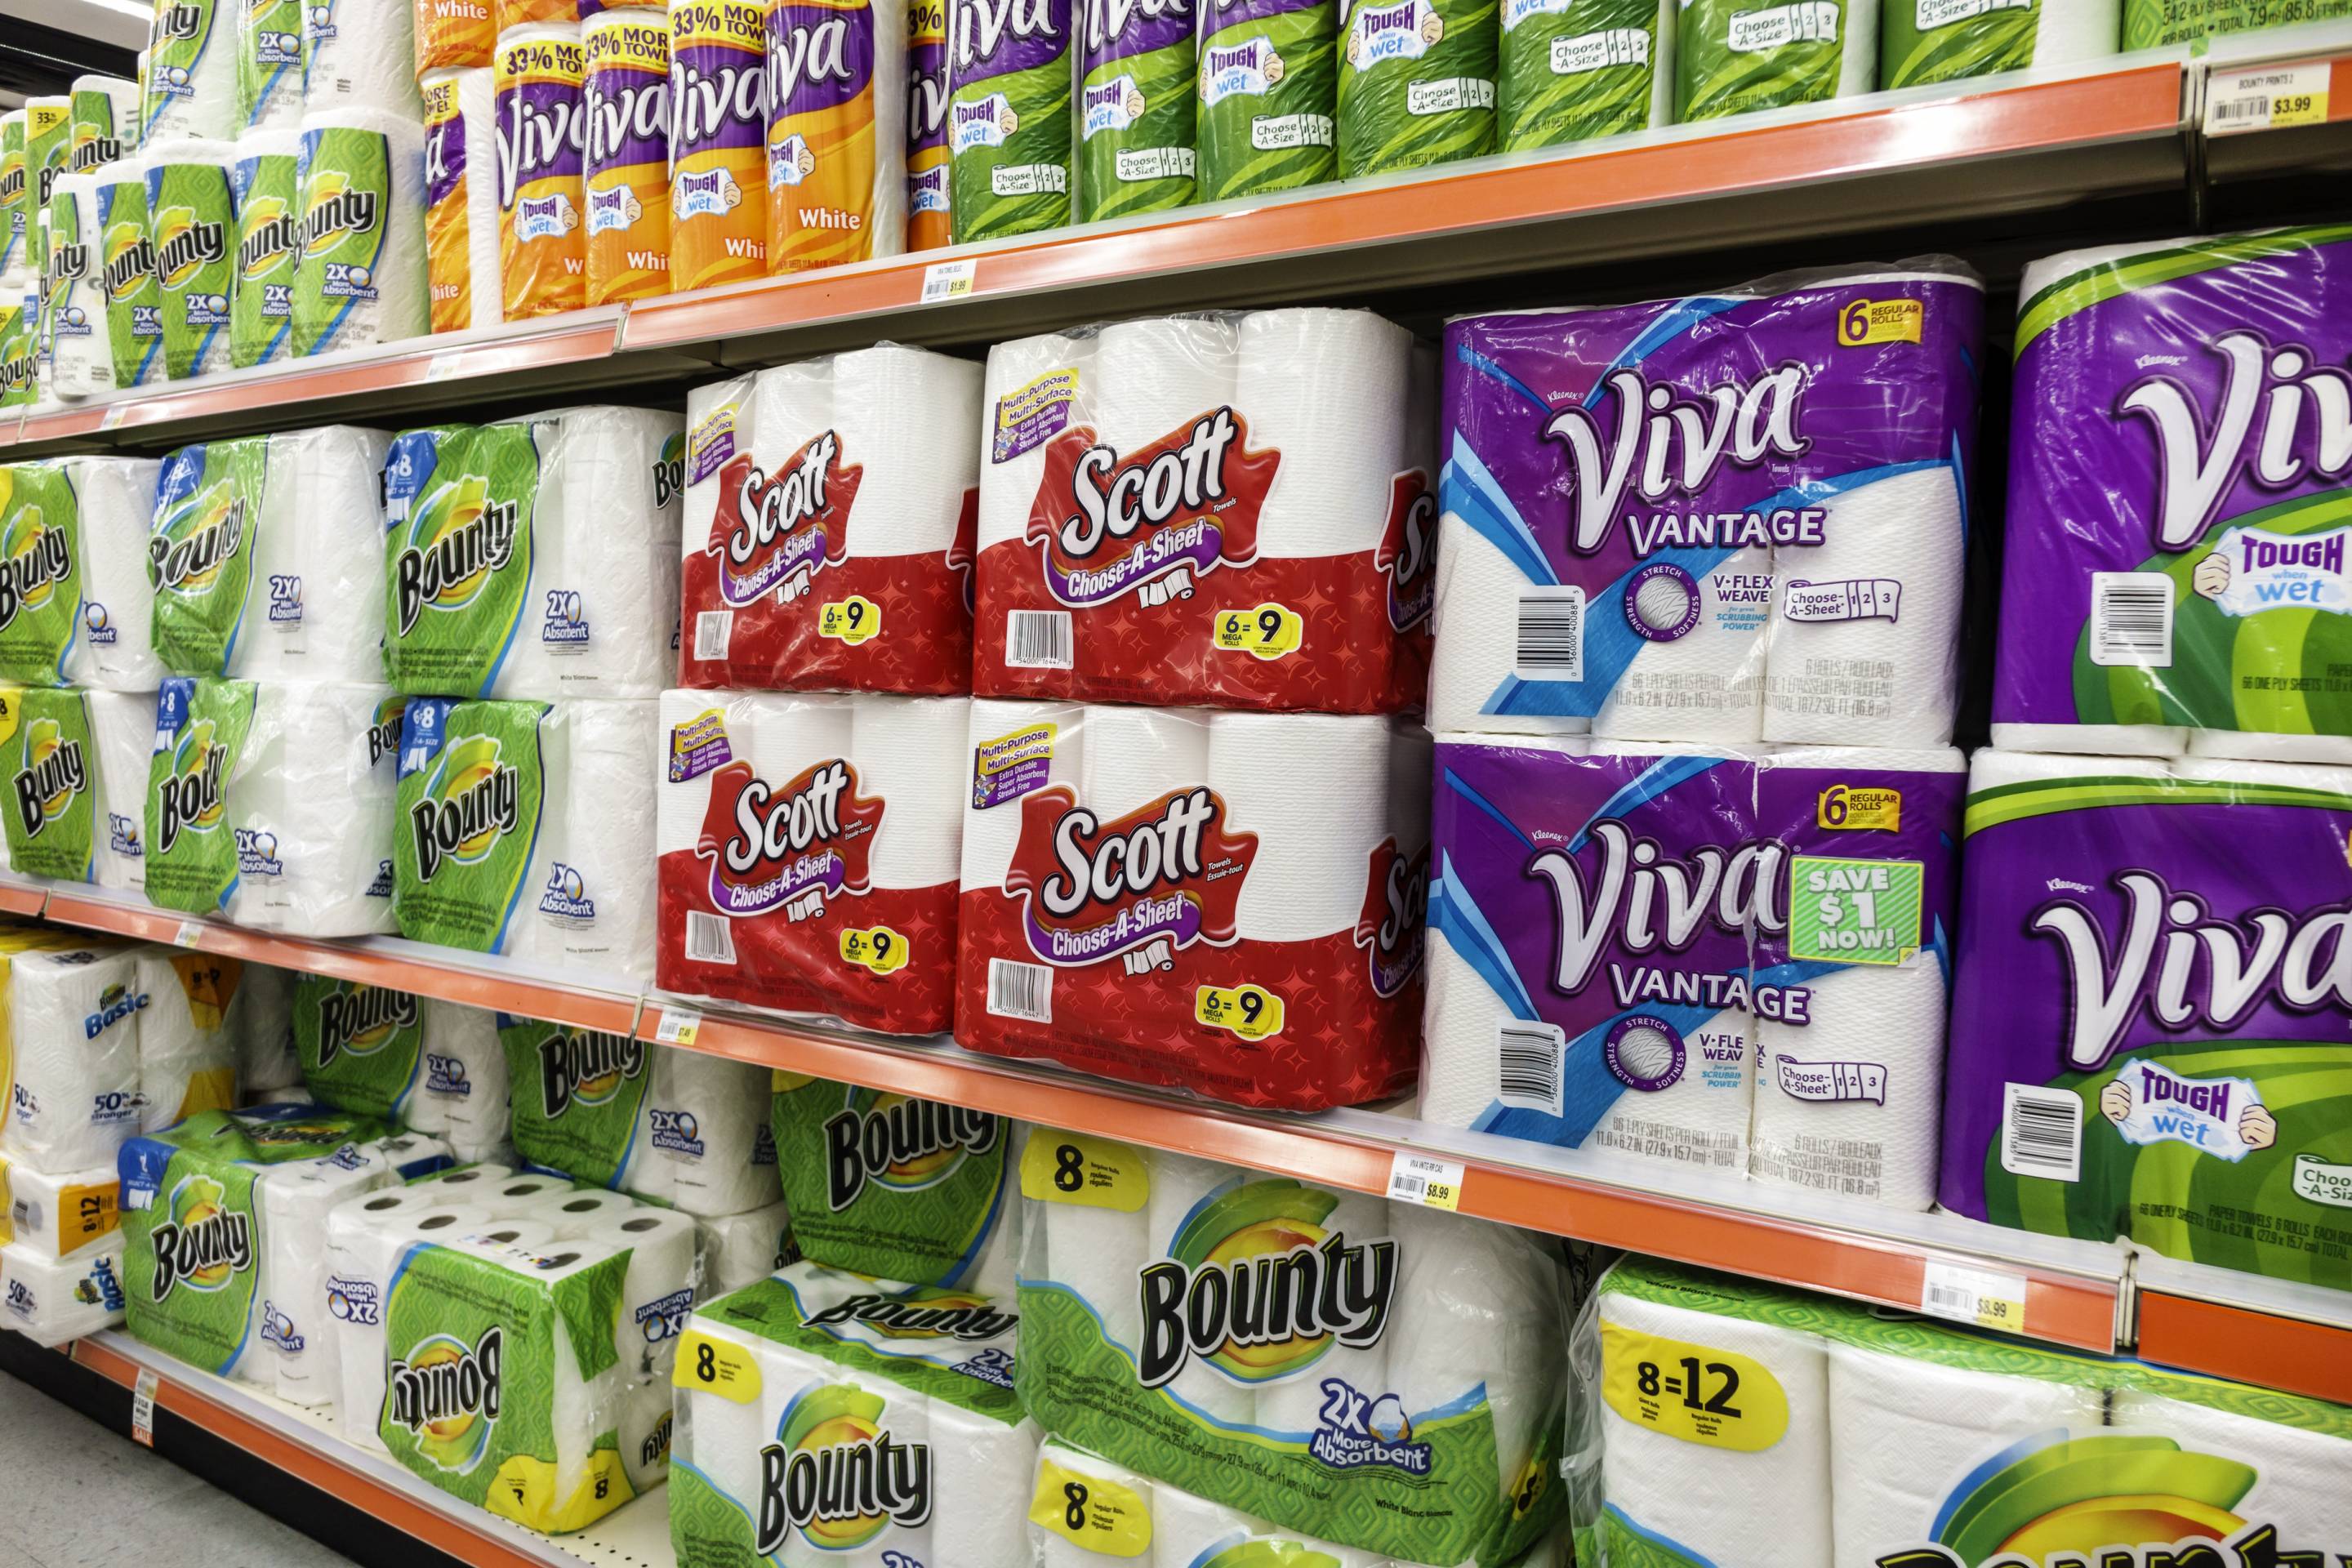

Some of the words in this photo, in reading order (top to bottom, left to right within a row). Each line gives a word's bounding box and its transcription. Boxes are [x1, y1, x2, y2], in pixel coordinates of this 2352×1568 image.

[436, 1, 488, 20] White
[1364, 2, 1414, 41] TOUGH
[2219, 15, 2244, 30] TOTAL
[2248, 6, 2267, 28] 7.9
[673, 7, 721, 38] 33%
[1735, 15, 1785, 34] Choose
[260, 33, 280, 48] 2X
[1370, 36, 1405, 58] wet
[1555, 41, 1602, 58] Choose
[506, 48, 552, 76] 33%
[1210, 47, 1257, 78] TOUGH
[1217, 74, 1249, 95] wet
[2238, 76, 2265, 90] BOUNTY
[2265, 74, 2287, 86] PRINTS
[1086, 79, 1122, 110] TOUGH
[1413, 87, 1456, 101] Choose
[2274, 96, 2311, 114] $3.99
[956, 98, 995, 124] TOUGH
[1089, 110, 1113, 130] wet
[961, 127, 987, 143] wet
[1256, 122, 1297, 136] Choose
[1120, 154, 1157, 169] Choose
[684, 172, 719, 195] TOUGH
[996, 171, 1031, 184] Choose
[523, 196, 557, 218] TOUGH
[593, 192, 621, 212] TOUGH
[688, 197, 711, 211] wet
[799, 207, 862, 230] White
[326, 265, 348, 280] 2X
[186, 295, 207, 310] 2X
[265, 286, 286, 301] 2X
[323, 286, 378, 299] Absorbent
[1846, 302, 1869, 341] 6
[1871, 305, 1920, 317] REGULAR
[1871, 314, 1904, 325] ROLLS
[1003, 375, 1070, 411] Multi-Purpose
[1009, 389, 1072, 423] Multi-Surface
[1019, 426, 1037, 441] Super
[1037, 412, 1065, 430] Absorbent
[1020, 417, 1036, 431] Extra
[1546, 363, 1810, 553] Viva
[1062, 405, 1238, 559] Scott
[730, 430, 836, 567] Scott
[1212, 497, 1237, 514] Towels
[1628, 510, 1826, 558] VANTAGE
[734, 527, 817, 600] Choose-A-Sheet
[1067, 518, 1205, 599] Choose-A-Sheet
[2241, 532, 2345, 576] TOUGH
[397, 499, 519, 638] Bounty
[1642, 566, 1682, 579] STRETCH
[2272, 569, 2308, 580] when
[1717, 590, 1769, 603] WEAVE
[1791, 593, 1844, 604] Choose-
[1864, 593, 1871, 604] 2
[1883, 593, 1891, 604] 3
[2255, 578, 2325, 604] wet
[548, 591, 568, 618] 2X
[1789, 603, 1844, 617] A-Sheet
[1625, 595, 1653, 639] STRENGTH
[1672, 595, 1699, 638] SOFTNESS
[1716, 613, 1767, 622] SCRUBBING
[1722, 622, 1758, 631] POWER
[543, 625, 589, 641] Absorbent
[1223, 633, 1242, 641] MEGA
[2289, 677, 2322, 692] SHEETS
[981, 731, 1049, 758] Multi-Purpose
[987, 744, 1050, 772] Multi-Surface
[998, 777, 1016, 791] Super
[1016, 769, 1046, 782] Absorbent
[999, 769, 1013, 782] Extra
[1014, 760, 1038, 773] Durable
[996, 787, 1017, 800] Streak
[1017, 782, 1031, 792] Free
[725, 758, 849, 874] Scott
[1825, 788, 1848, 826] 6
[1850, 794, 1898, 804] REGULAR
[1850, 801, 1882, 811] ROLLS
[411, 764, 519, 884] Bounty
[844, 818, 863, 831] Towels
[1041, 786, 1214, 916] Scott
[1206, 862, 1244, 881] Essuie-tout
[1207, 857, 1232, 871] Towels
[730, 850, 832, 908] Choose-A-Sheet
[1808, 867, 1891, 893] SAVE
[1527, 818, 1790, 993] Viva
[1052, 890, 1183, 956] Choose-A-Sheet
[1818, 927, 1896, 951] NOW!
[845, 947, 862, 956] MEGA
[2032, 871, 2352, 1068] Viva
[1610, 962, 1810, 1026] VANTAGE
[85, 992, 150, 1040] Basic
[1204, 1008, 1223, 1018] MEGA
[1625, 1018, 1669, 1032] STRETCH
[1606, 1042, 1635, 1087] STRENGTH
[1655, 1050, 1686, 1090] SOFTNESS
[1782, 1066, 1831, 1084] Choose-
[1783, 1079, 1832, 1094] A-Sheet
[1849, 1076, 1857, 1087] 2
[1869, 1076, 1877, 1088] 3
[2141, 1066, 2231, 1124] TOUGH
[91, 1109, 133, 1121] stronger
[651, 1109, 677, 1132] 2X
[2166, 1105, 2195, 1121] when
[2152, 1111, 2212, 1146] wet
[653, 1135, 704, 1156] Absorbent
[824, 1099, 999, 1213] Bounty
[1054, 1144, 1085, 1192] 8
[1427, 1183, 1450, 1200] $8.99
[152, 1207, 252, 1303] Bounty
[2322, 1244, 2348, 1260] TOTAL
[1646, 1280, 1677, 1291] White
[1679, 1285, 1713, 1298] Blanc
[798, 1294, 1020, 1341] Bounty
[1138, 1230, 1401, 1390] Bounty
[1977, 1297, 2007, 1318] $8.99
[697, 1342, 716, 1383] 8
[952, 1364, 1014, 1388] Absorbe
[1323, 1382, 1369, 1435] 2X
[1332, 1428, 1372, 1450] More
[1312, 1432, 1430, 1472] Absorbent
[758, 1432, 933, 1557] Bounty
[1063, 1481, 1089, 1530] 8
[1375, 1498, 1400, 1512] White
[1401, 1505, 1424, 1517] Blanc
